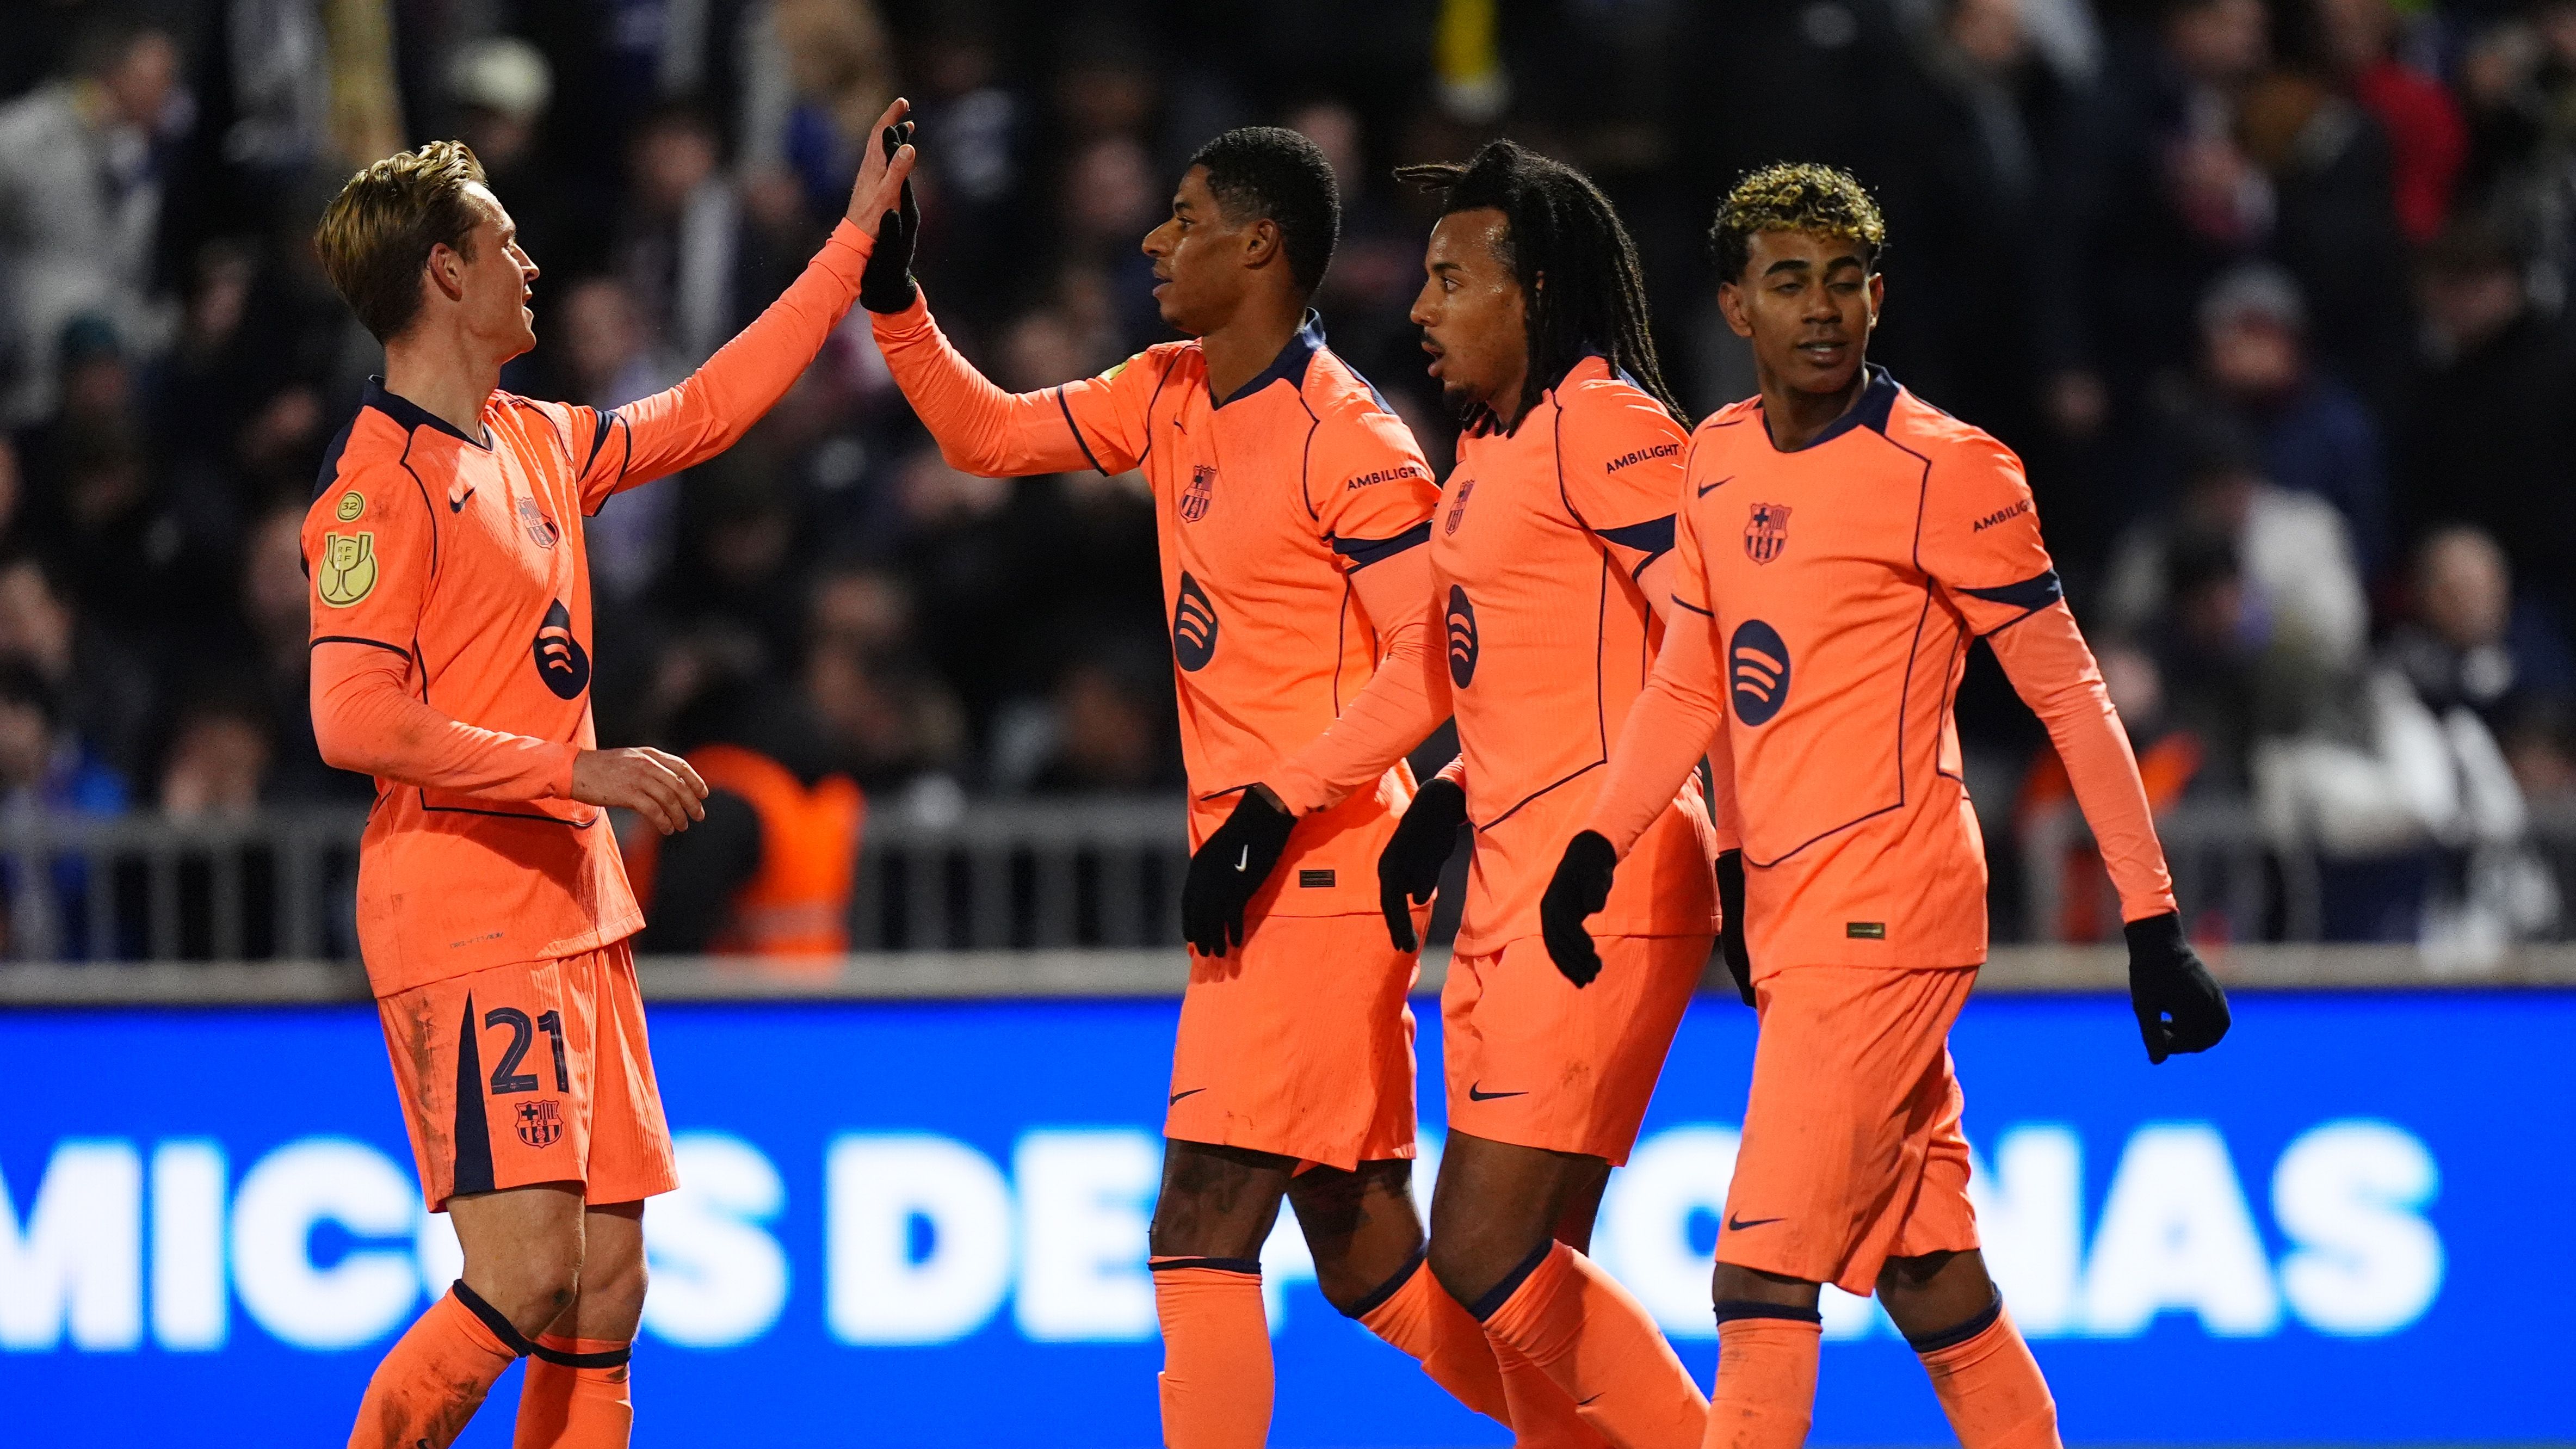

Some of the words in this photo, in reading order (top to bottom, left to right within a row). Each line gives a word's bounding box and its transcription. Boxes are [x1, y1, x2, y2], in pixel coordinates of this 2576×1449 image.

[1607, 444, 1679, 474] AMBILIGHT
[342, 502, 357, 510] 32
[1973, 500, 2030, 533] AMBILIG
[485, 1007, 569, 1095] 21
[0, 1131, 789, 1352] MICS
[821, 1129, 1170, 1347] DE
